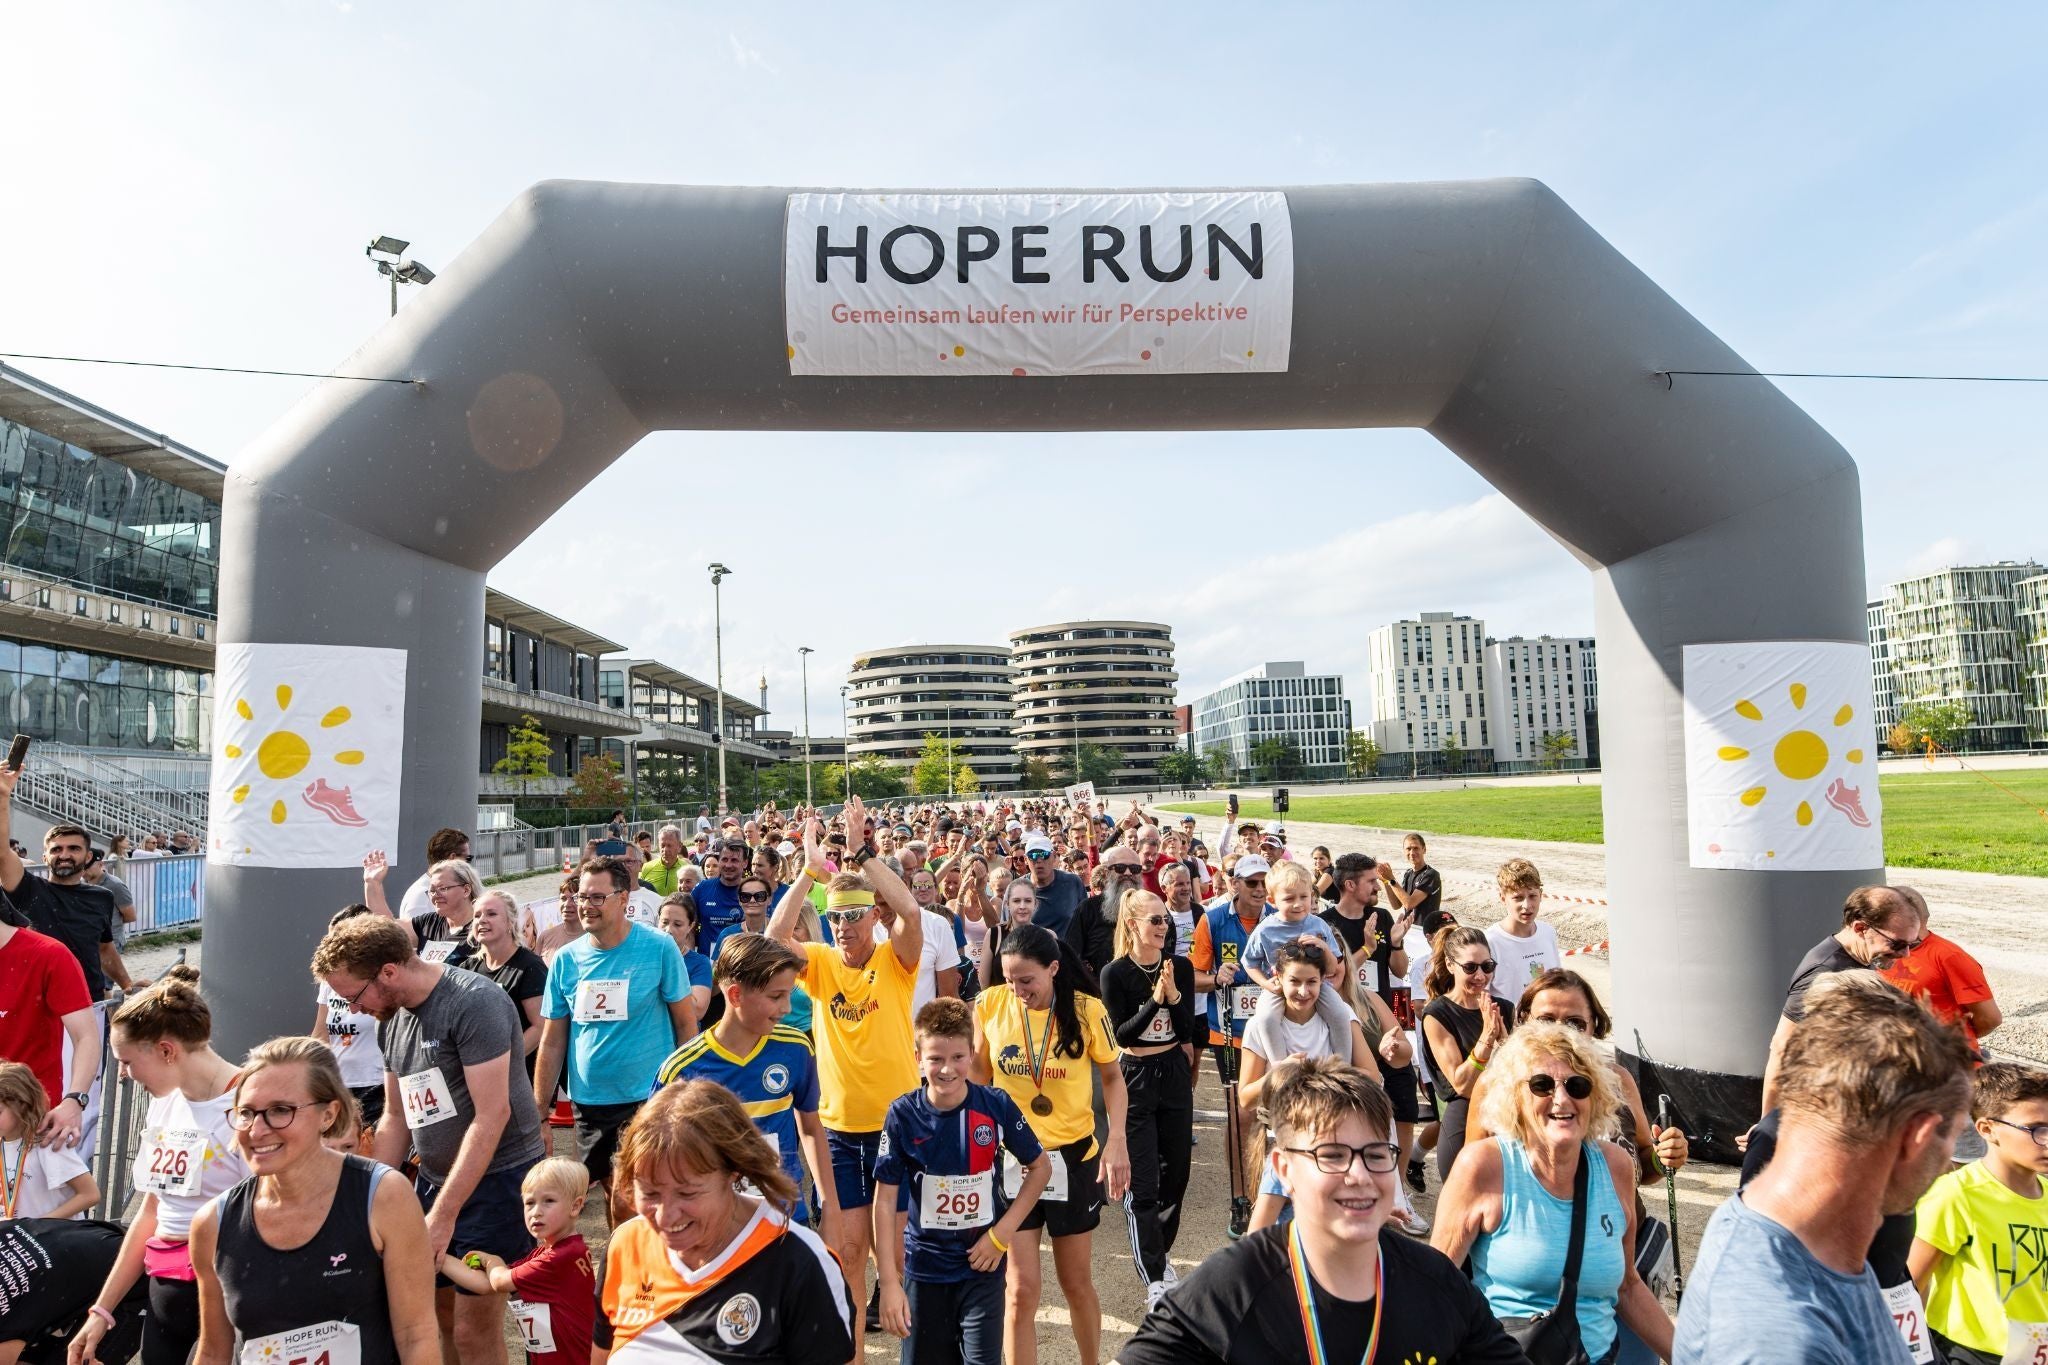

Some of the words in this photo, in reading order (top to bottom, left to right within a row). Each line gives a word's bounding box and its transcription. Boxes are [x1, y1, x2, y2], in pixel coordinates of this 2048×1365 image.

[816, 224, 1051, 285] HOPE
[1082, 222, 1264, 283] RUN
[831, 303, 960, 325] Gemeinsam
[967, 303, 1036, 325] laufen
[1041, 304, 1077, 323] wir
[1081, 302, 1114, 323] für
[1119, 301, 1248, 327] Perspektive
[1073, 789, 1091, 801] 866
[426, 950, 448, 961] 876
[595, 993, 607, 1010] 2
[328, 1023, 360, 1036] MALE.
[1007, 1063, 1031, 1076] WOR
[1045, 1067, 1067, 1079] RUN
[408, 1087, 438, 1113] 414
[150, 1147, 189, 1177] 226
[936, 1192, 980, 1215] 269
[284, 1330, 313, 1345] HOPE
[315, 1323, 339, 1337] RUN
